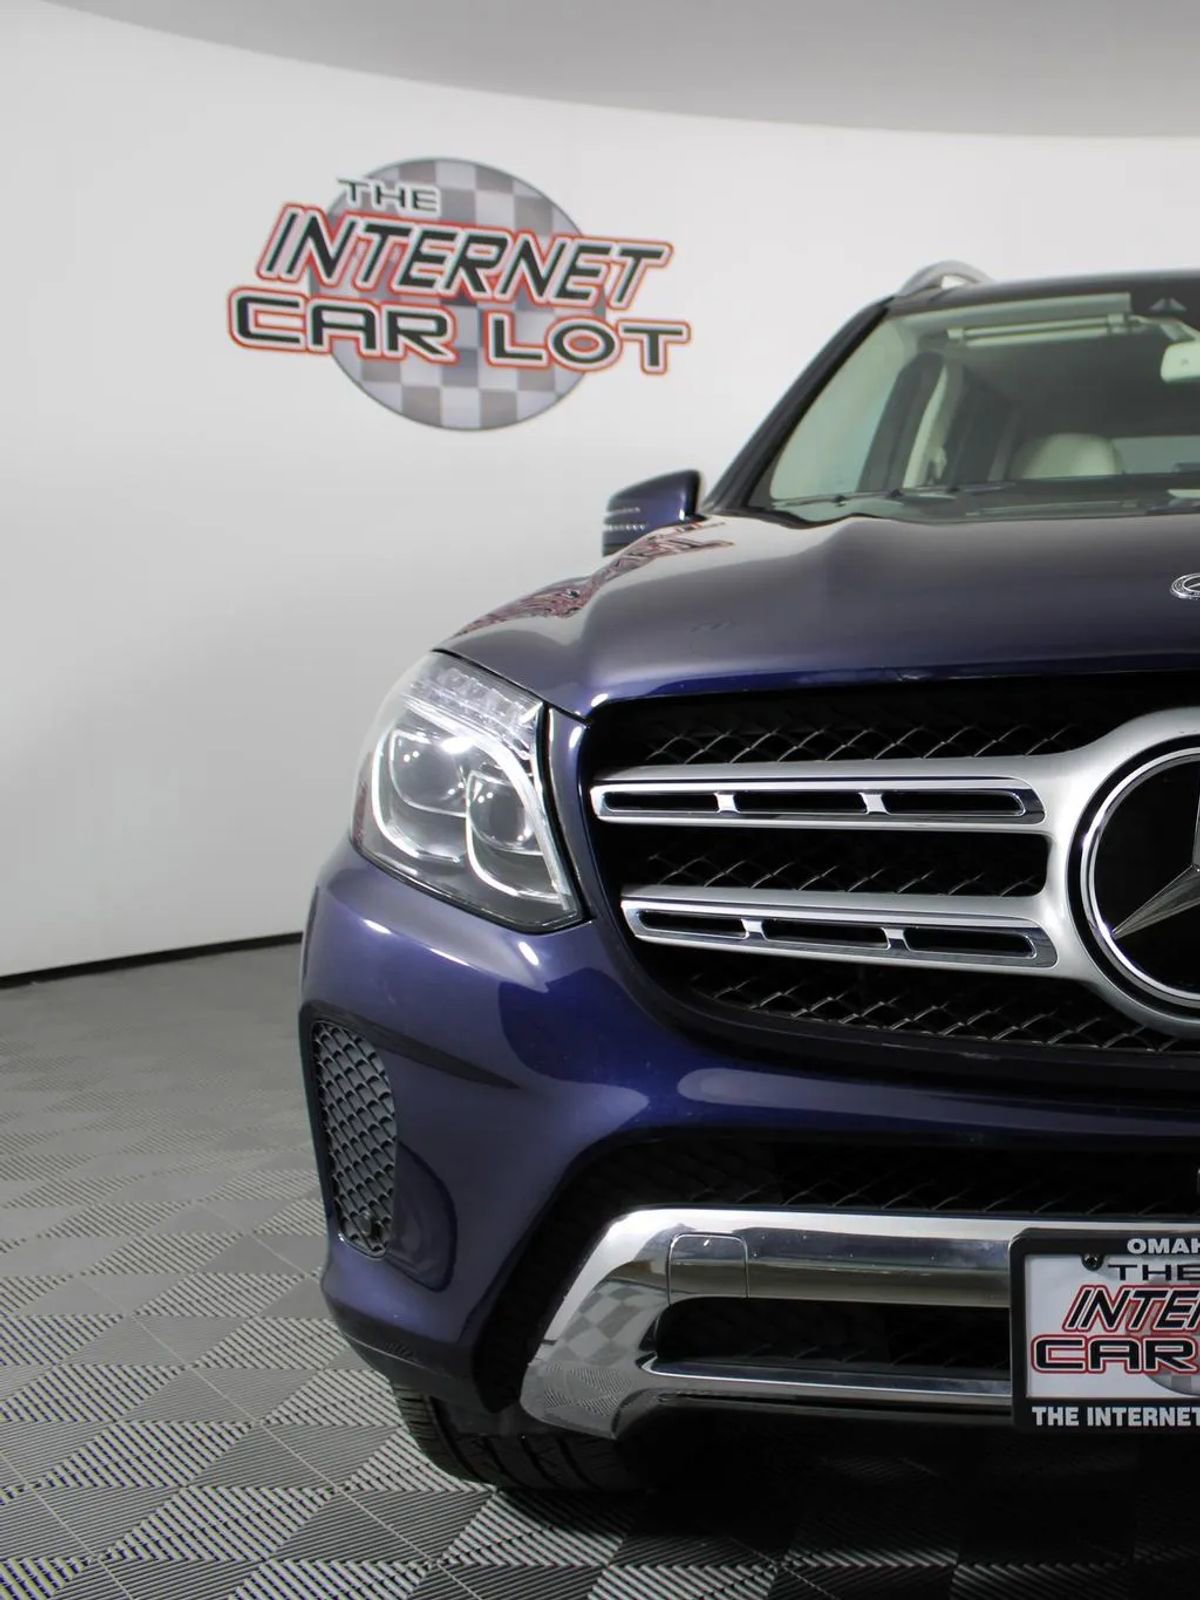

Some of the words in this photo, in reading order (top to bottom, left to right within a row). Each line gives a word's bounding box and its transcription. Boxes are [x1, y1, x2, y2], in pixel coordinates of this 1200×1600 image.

[337, 178, 440, 213] THE
[261, 207, 669, 305] INTERNET
[233, 290, 455, 362] CAR
[489, 314, 687, 370] LOT
[1108, 1264, 1200, 1281] THE
[1033, 1335, 1199, 1372] CAR
[1032, 1407, 1079, 1426] THE
